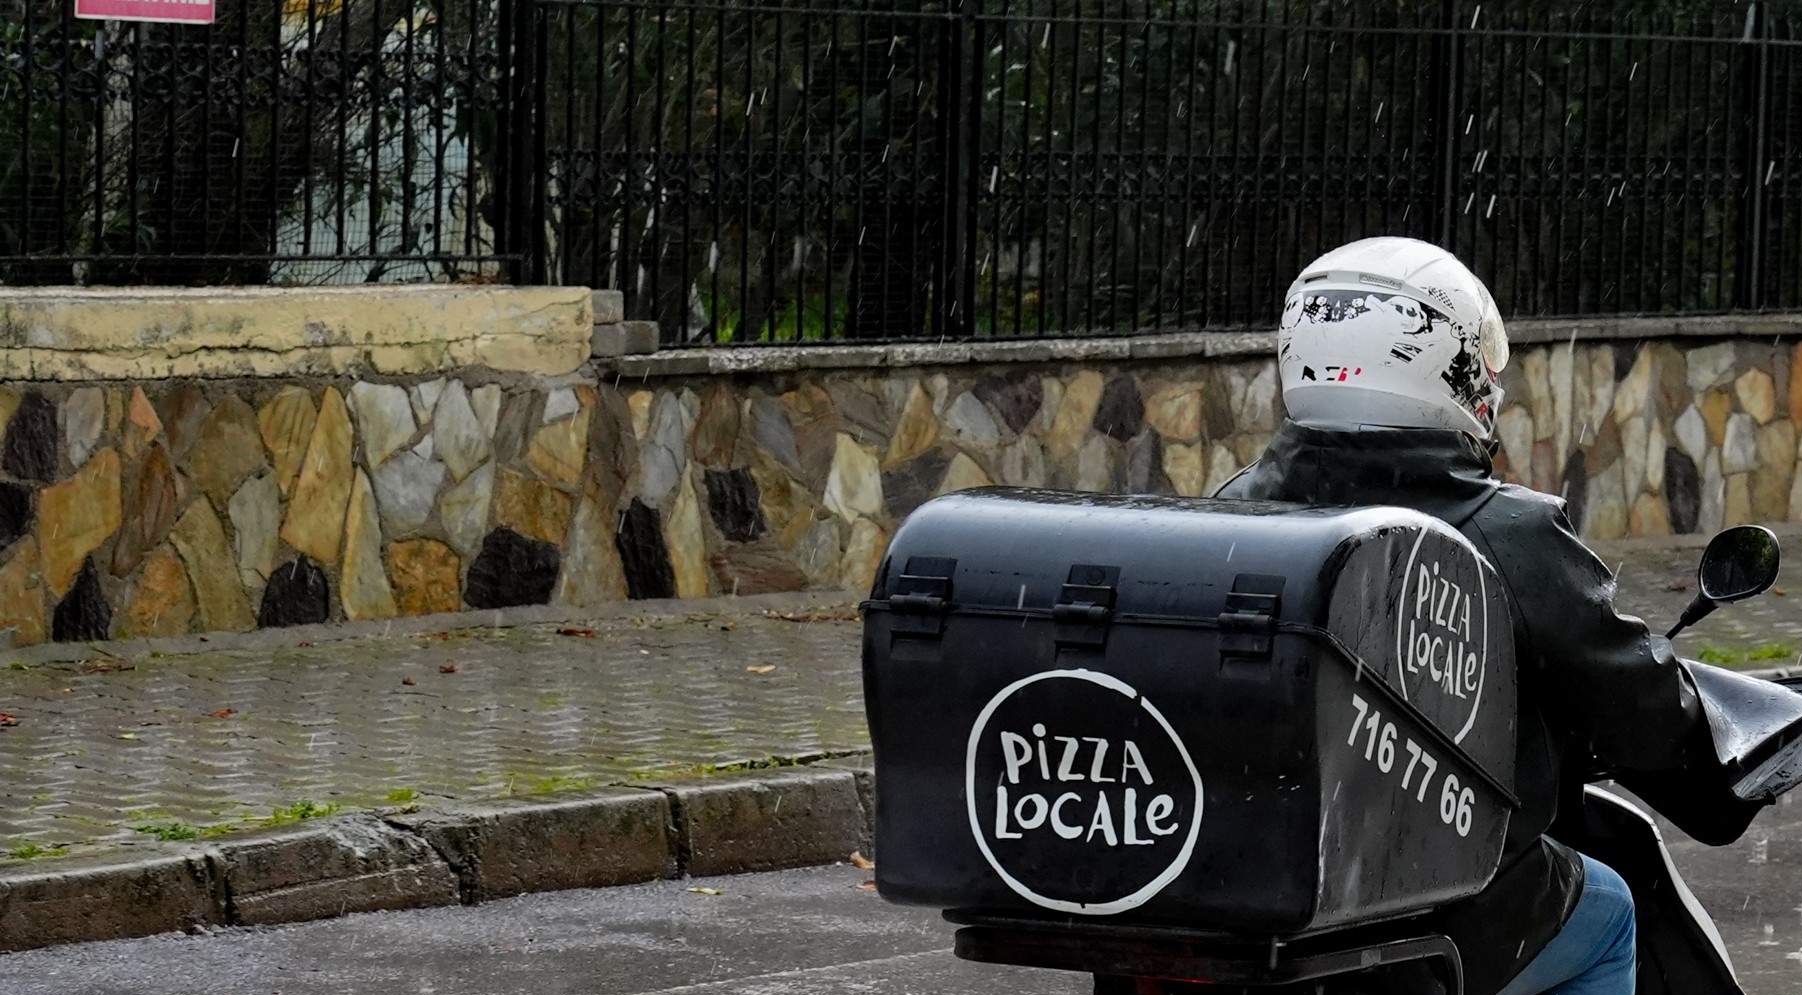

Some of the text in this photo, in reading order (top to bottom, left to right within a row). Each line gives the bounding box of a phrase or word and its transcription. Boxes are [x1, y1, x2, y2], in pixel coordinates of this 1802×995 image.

[1347, 693, 1475, 837] 716 77 66
